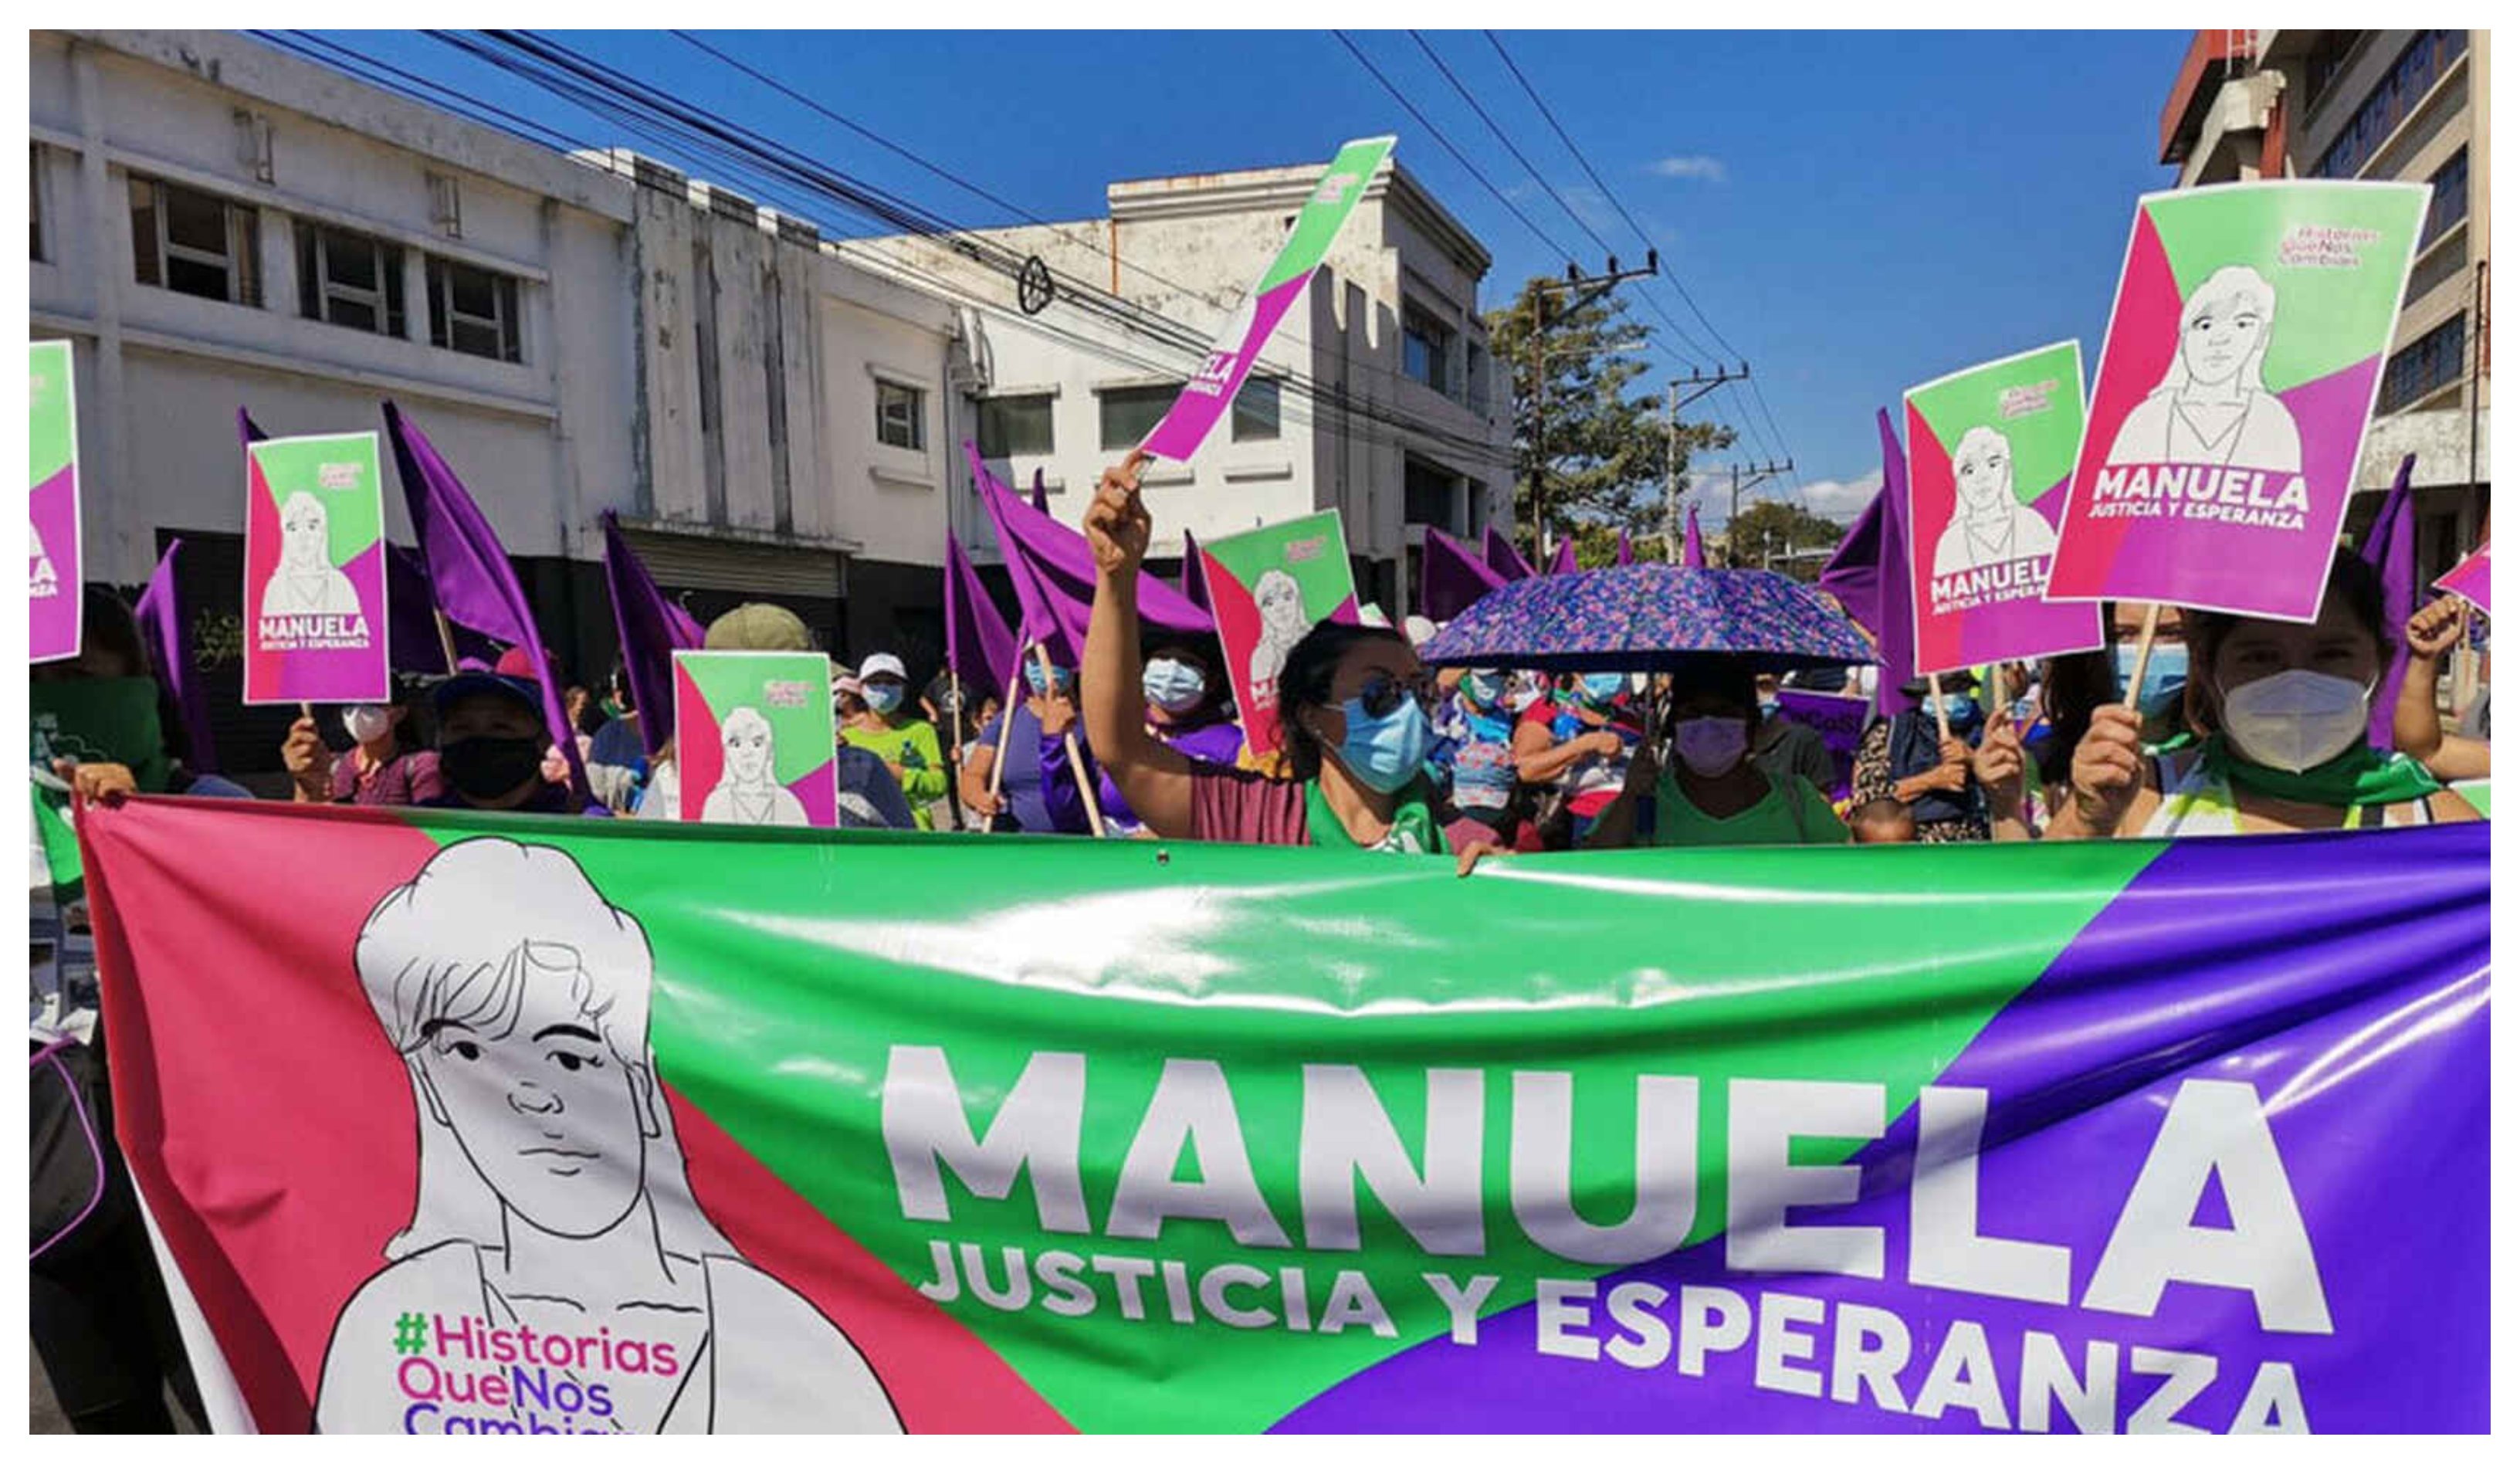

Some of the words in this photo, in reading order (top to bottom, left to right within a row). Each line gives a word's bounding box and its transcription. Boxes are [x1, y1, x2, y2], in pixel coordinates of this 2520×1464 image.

[2088, 500, 2161, 518] JUSTICIA
[2168, 503, 2181, 517] Y
[2183, 503, 2304, 530] ESPERANZA
[2092, 466, 2309, 513] MANUELA
[1931, 558, 2048, 604] MANUEL
[259, 616, 370, 640] MANUELA
[882, 1045, 2335, 1334] MANUELA
[393, 1312, 679, 1378] #Historias
[919, 1240, 1398, 1338] JUSTICIA
[1422, 1273, 1500, 1346] Y
[1536, 1278, 2314, 1435] ESPERANZA
[398, 1356, 614, 1418] QueNos
